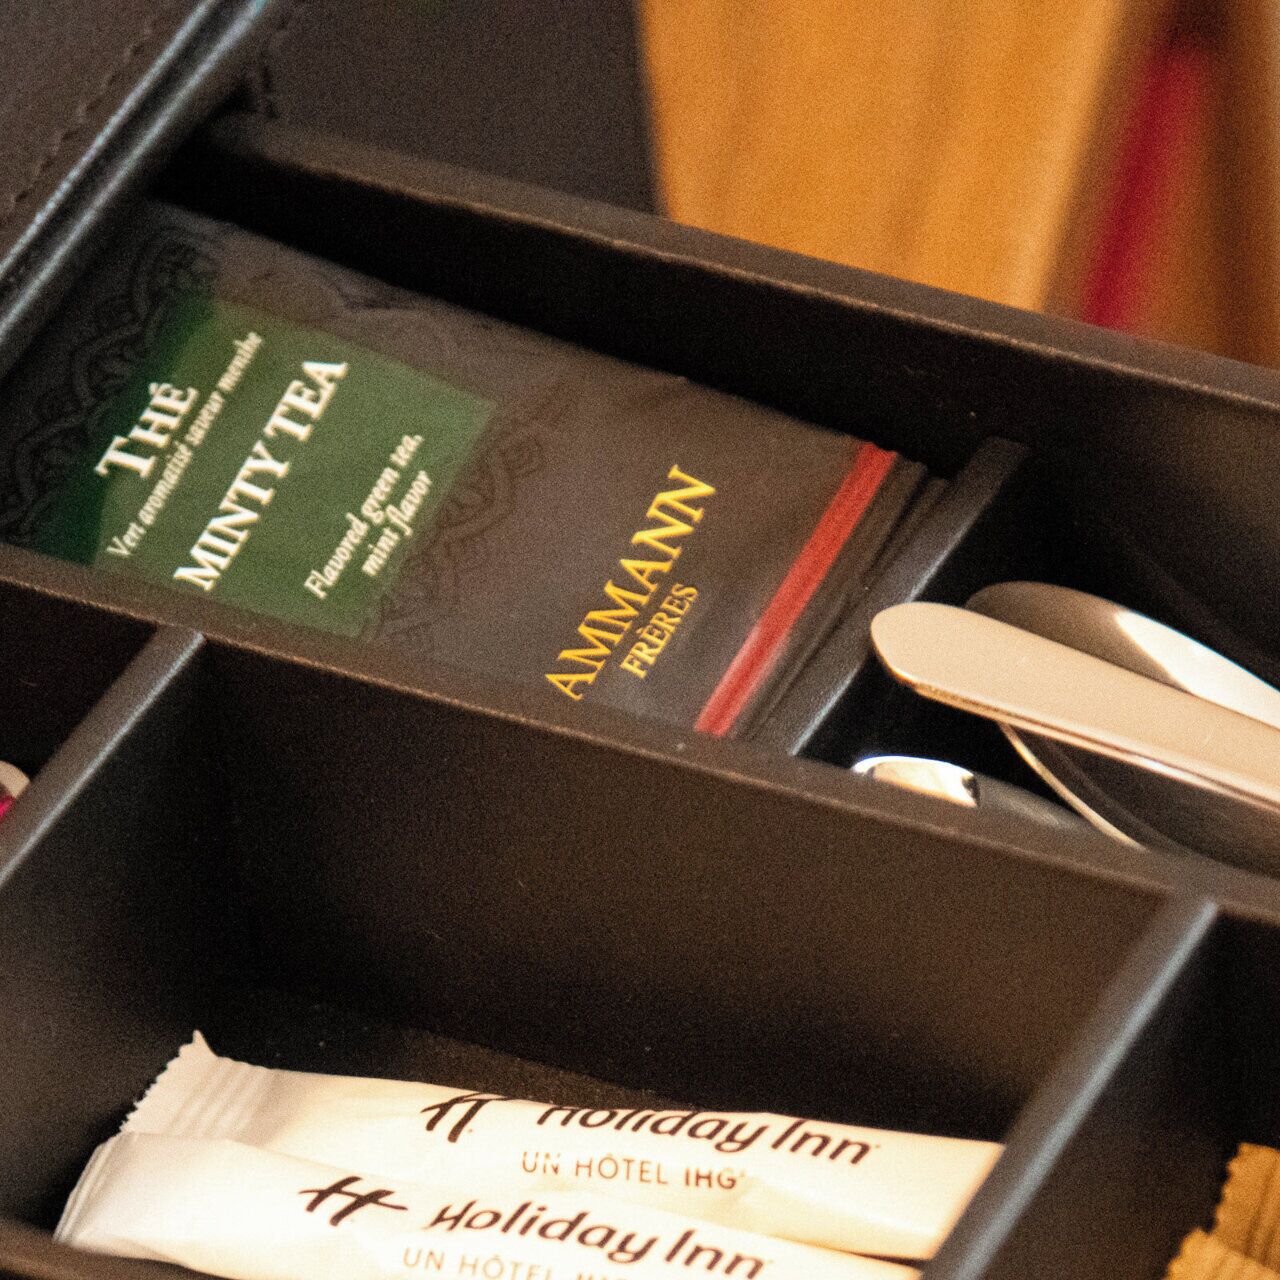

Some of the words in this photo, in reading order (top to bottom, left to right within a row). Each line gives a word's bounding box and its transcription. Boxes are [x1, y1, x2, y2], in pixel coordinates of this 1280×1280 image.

[106, 521, 147, 559] Vert
[136, 441, 194, 523] aromatisé
[173, 439, 291, 591] MINTY
[264, 359, 349, 442] TEA
[361, 526, 401, 577] mint
[387, 469, 433, 537] flavor
[303, 511, 370, 599] Flavored
[358, 464, 401, 525] green
[544, 464, 717, 702] AMMANN
[620, 583, 699, 679] FRÈRES
[521, 1150, 561, 1176] UN
[574, 1152, 670, 1186] HÔTEL
[682, 1166, 739, 1191] IHG
[770, 1118, 876, 1167] Inn
[402, 1247, 447, 1272] UN
[422, 1198, 660, 1265] Holiday
